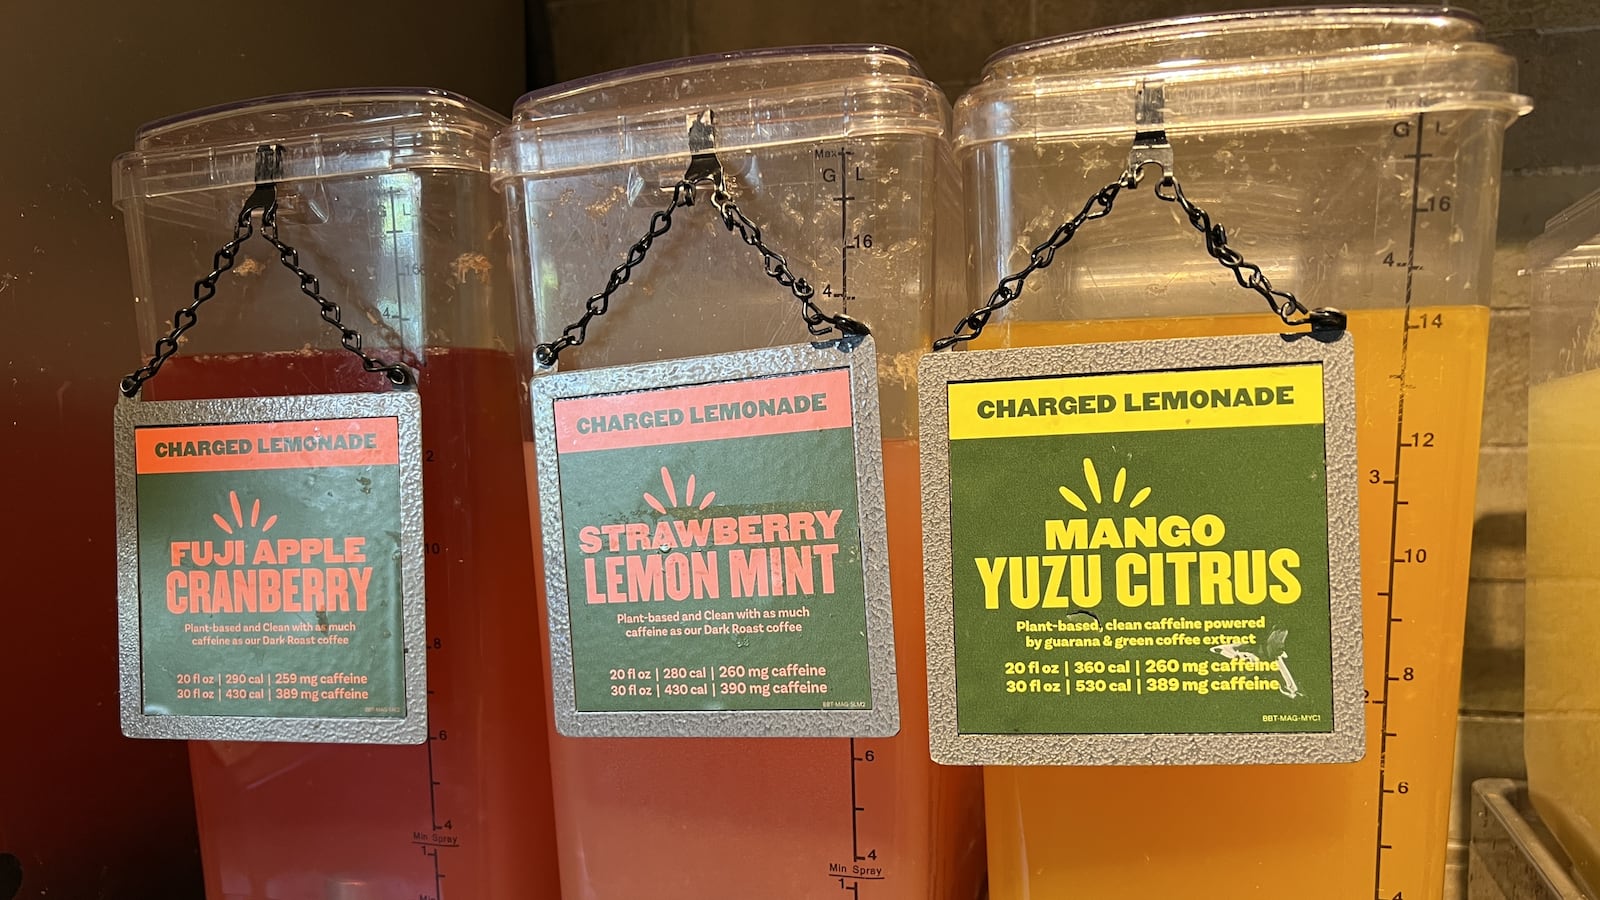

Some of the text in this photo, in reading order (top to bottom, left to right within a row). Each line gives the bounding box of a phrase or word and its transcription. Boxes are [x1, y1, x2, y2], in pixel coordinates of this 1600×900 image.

[1393, 121, 1410, 138] G
[815, 149, 838, 159] Max
[822, 168, 836, 183] G
[856, 167, 864, 181] L
[1429, 196, 1451, 212] 16
[853, 234, 873, 249] 16
[1382, 251, 1394, 267] 4
[822, 284, 832, 297] 4
[382, 307, 390, 319] 4
[1419, 313, 1443, 329] 14
[976, 386, 1294, 420] CHARGED LEMONADE
[576, 393, 827, 435] CHARGED LEMONADE
[155, 433, 377, 458] CHARGED LEMONADE
[1411, 432, 1435, 447] 12
[1369, 469, 1380, 484] 3
[579, 509, 843, 554] STRAWBERRY
[1045, 513, 1226, 550] MANGO
[171, 537, 366, 567] FUJI APPLE
[1404, 548, 1427, 563] 10
[584, 544, 839, 605] LEMON MINT
[974, 547, 1302, 609] YUZU CITRUS
[166, 567, 373, 614] CRANBERRY
[617, 606, 810, 624] Plant-based and Clean with as much
[185, 621, 356, 633] Plant-based and Clean with as much
[625, 621, 802, 638] caffeine as our Dark Roast coffee
[1016, 616, 1266, 633] Plant-based, clean caffeine powered
[192, 636, 230, 646] caffeine
[245, 637, 261, 645] our
[262, 635, 285, 645] Dark
[287, 635, 315, 645] Roast
[317, 635, 349, 645] coffee
[434, 638, 442, 649] 8
[1025, 633, 1257, 650] by guarana & green coffee extract
[609, 664, 826, 680] 20 fl oz 280 cal 260 mg caffeine
[1005, 658, 1279, 676] 20 fl oz 360 cal 260 mg caffeine
[1403, 667, 1414, 681] 8
[177, 672, 368, 687] 20 fl oz 290 cal 259 mg caffeine
[1006, 676, 1280, 694] 30 fl oz 530 cal 389 mg caffeine
[177, 688, 369, 702] 30 fl oz 430 cal 389 mg caffeine
[611, 681, 828, 697] 30 fl oz 430 cal 390 mg caffeine
[1262, 714, 1321, 722] BBT-MAG-MYC1
[439, 730, 448, 741] 6
[865, 750, 875, 762] 6
[1397, 781, 1409, 794] 6
[444, 820, 453, 830] 4
[413, 832, 457, 844] Min Spray
[421, 846, 427, 856] 1
[867, 849, 877, 860] 4
[829, 863, 882, 876] Min Spray
[838, 878, 845, 889] 1
